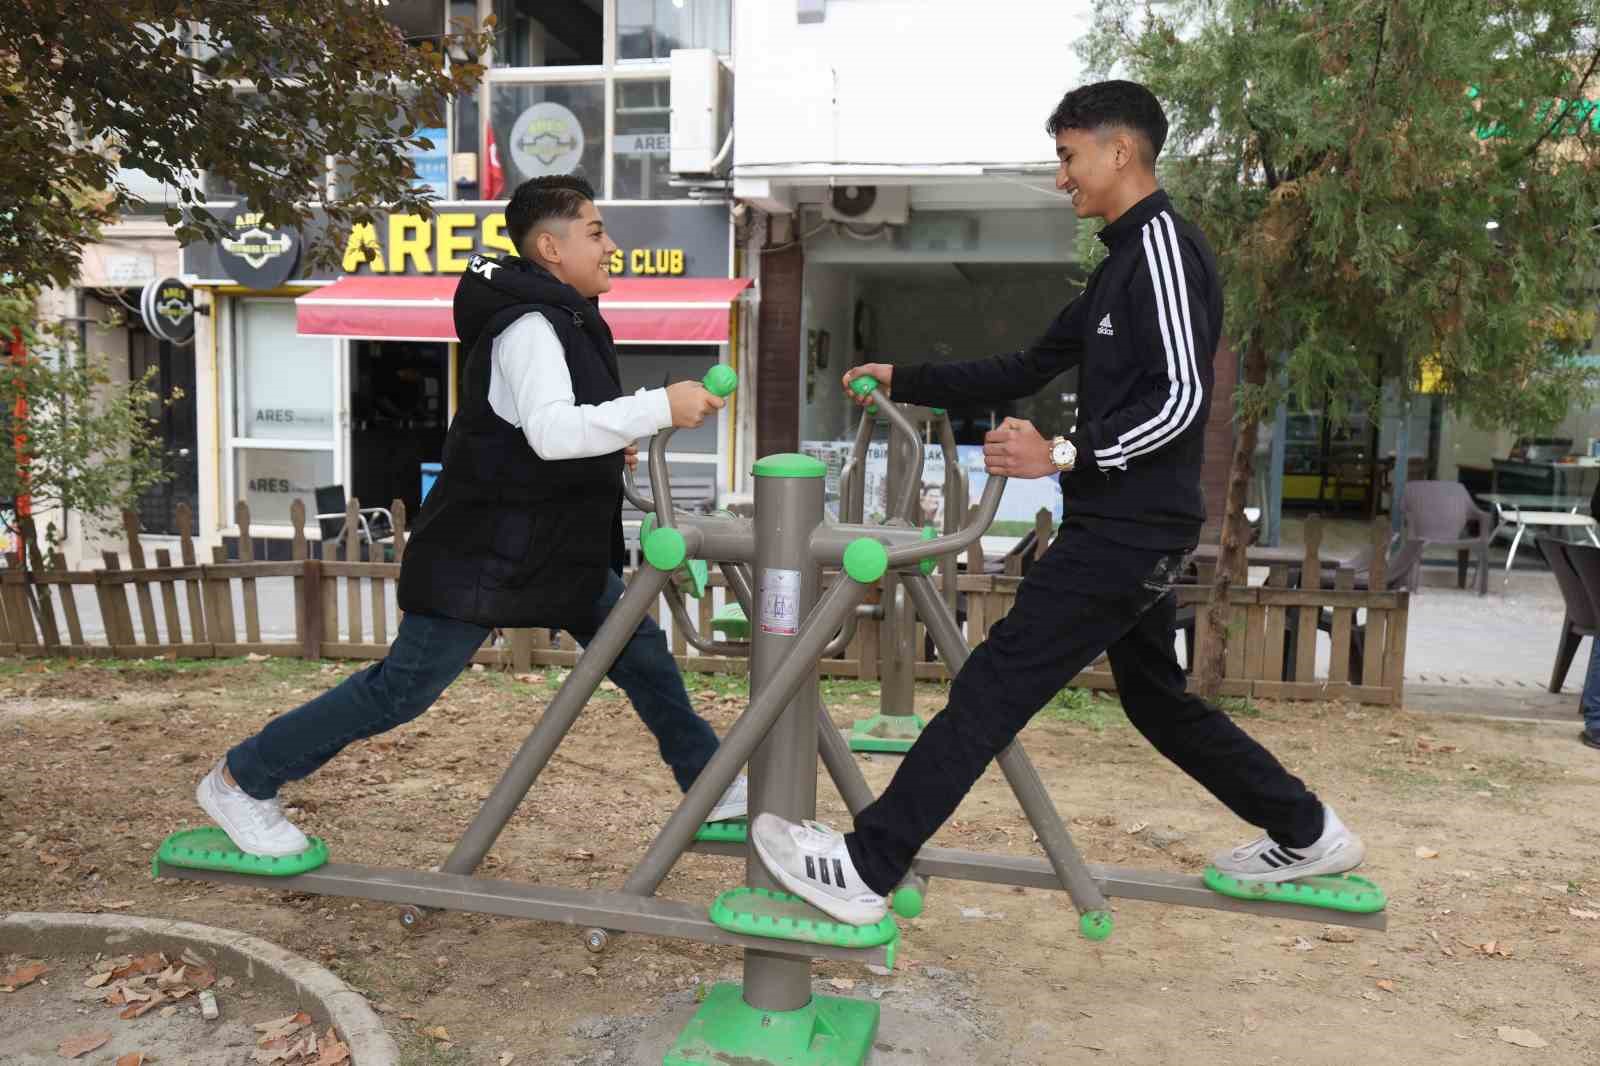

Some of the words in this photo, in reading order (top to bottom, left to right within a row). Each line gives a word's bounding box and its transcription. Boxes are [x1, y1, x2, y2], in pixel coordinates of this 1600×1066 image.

[634, 135, 671, 150] ARE
[630, 248, 684, 275] CLUB
[1096, 325, 1114, 336] adidas
[255, 408, 295, 422] ARES
[247, 478, 289, 493] ARES
